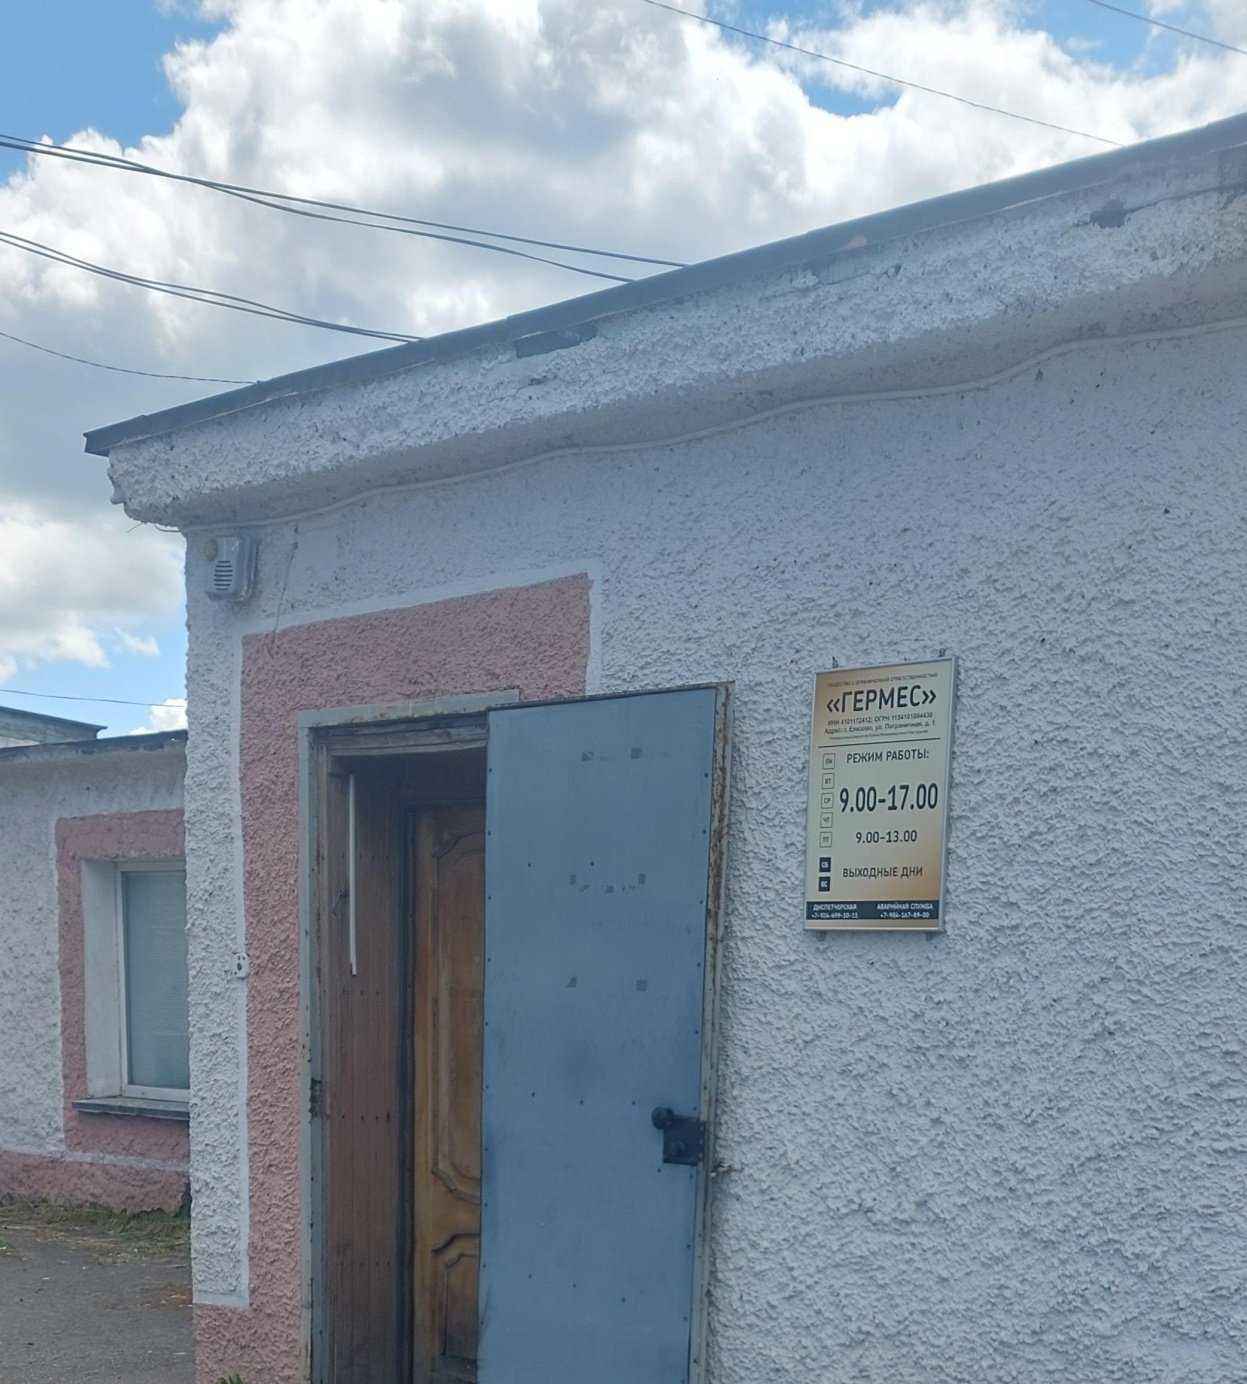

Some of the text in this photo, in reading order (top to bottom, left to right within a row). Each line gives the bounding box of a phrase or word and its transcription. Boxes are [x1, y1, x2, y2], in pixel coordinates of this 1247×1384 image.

[826, 684, 937, 713] «ГЕРМЕС»
[846, 749, 930, 764] РЕЖИМ РАБОТЫ:
[839, 783, 938, 813] 9.00-17.00
[855, 830, 918, 844] 9.00-13.00
[842, 866, 924, 879] ВЫХОДНЫЕ ДНИ
